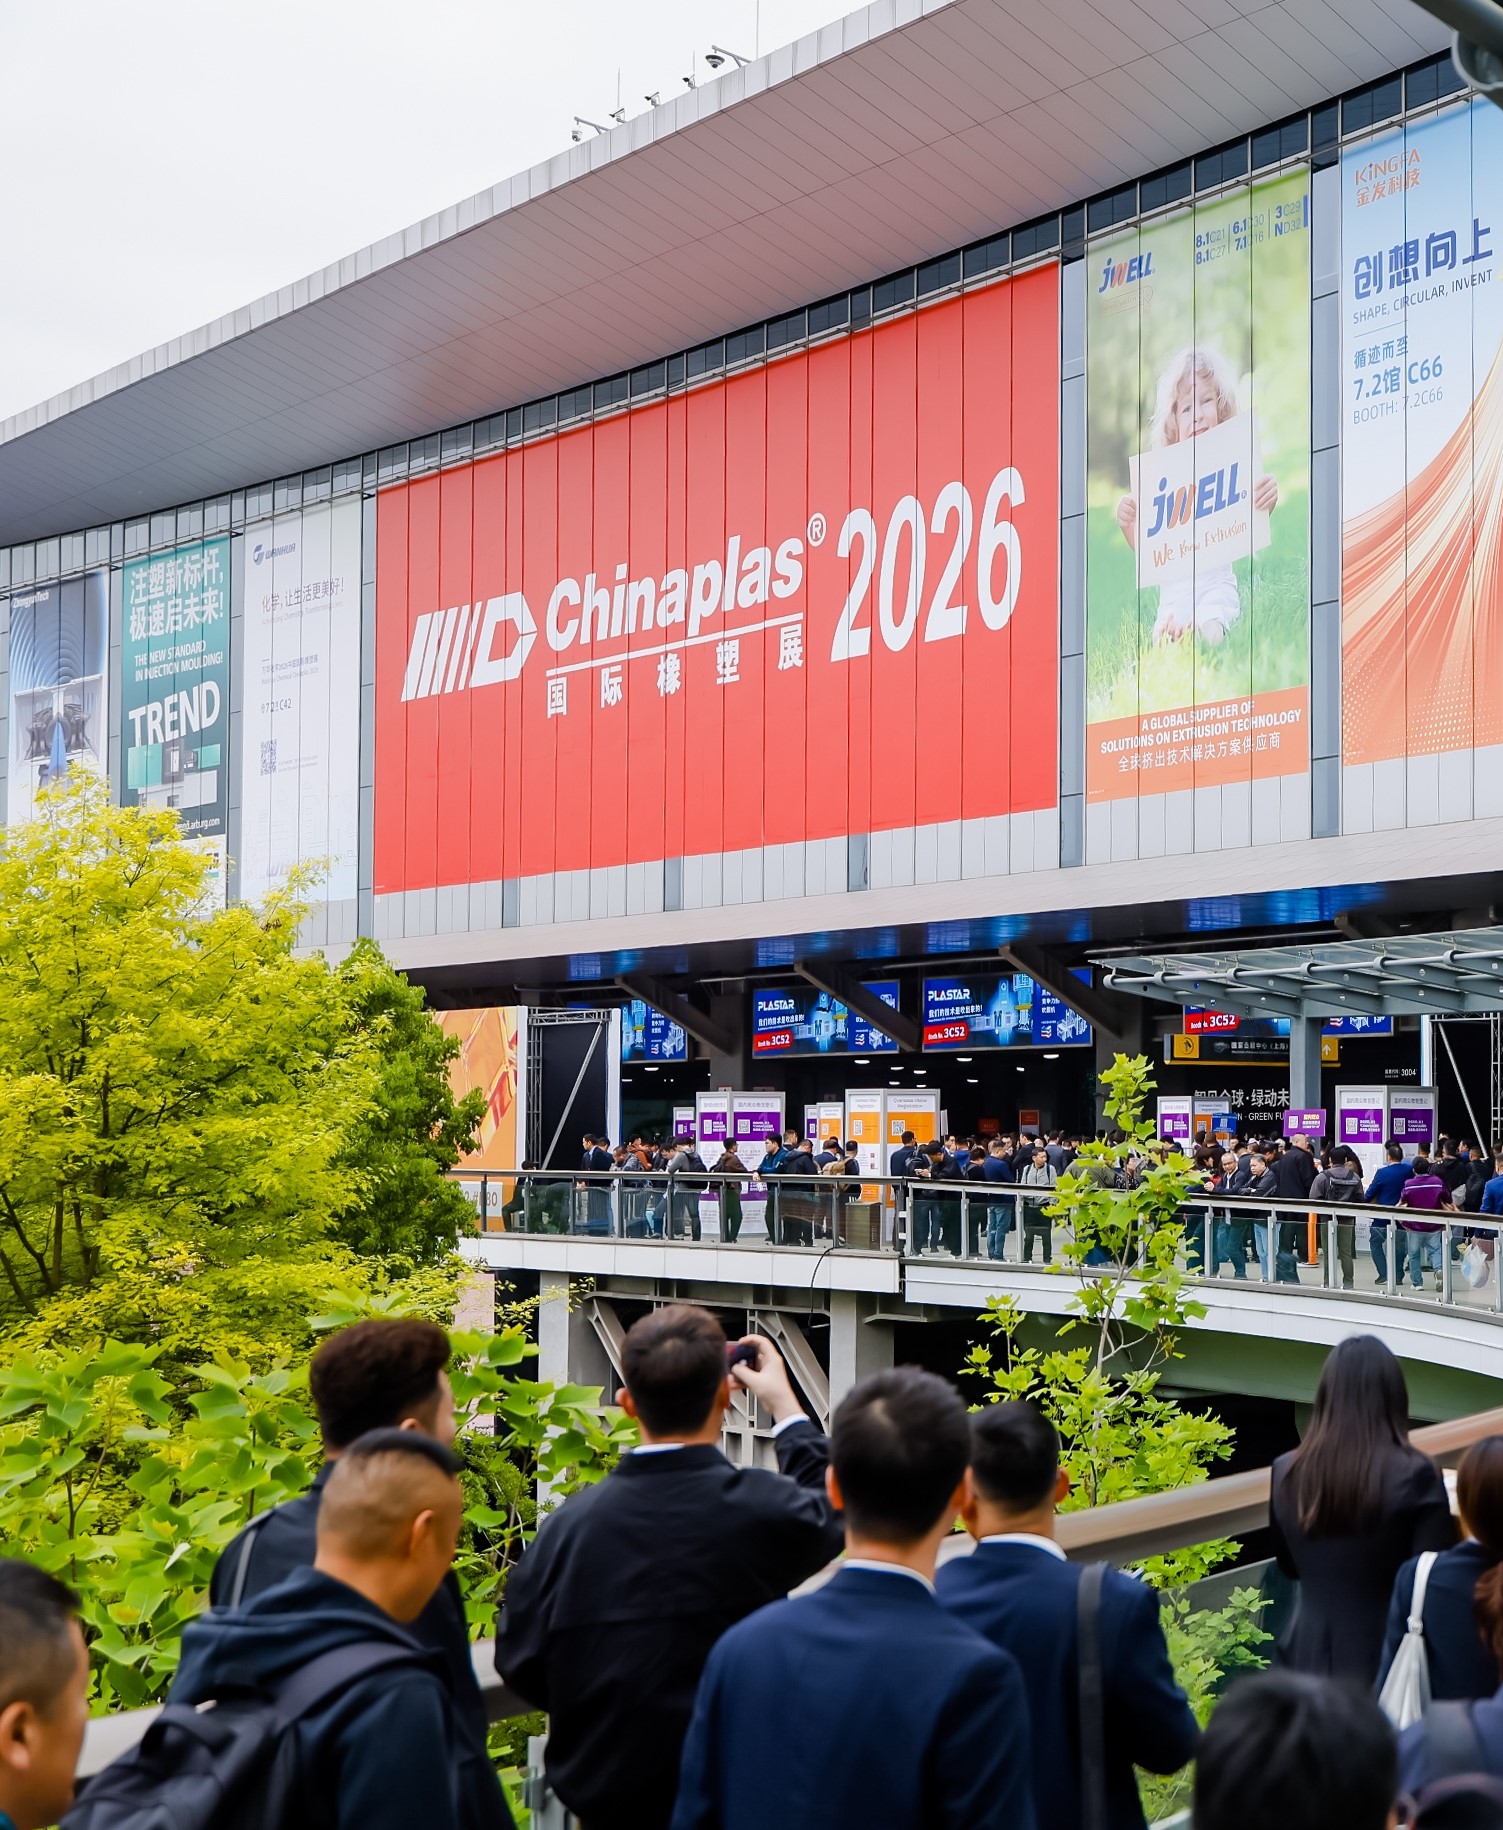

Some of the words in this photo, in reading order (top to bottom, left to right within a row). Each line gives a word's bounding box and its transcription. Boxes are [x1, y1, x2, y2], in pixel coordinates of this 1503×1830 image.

[1355, 167, 1421, 208] 金发科技
[1196, 228, 1225, 248] 8.1C21
[1275, 201, 1301, 218] 3C29
[1196, 245, 1226, 265] 8.1C27
[1275, 218, 1301, 237] ND32
[1353, 217, 1493, 300] 创想向上
[1353, 303, 1391, 324] SHAPE,
[1393, 282, 1448, 311] CIRCULAR,
[1451, 269, 1493, 292] INVENT
[1354, 335, 1409, 369] 循迹而至
[1354, 365, 1401, 401] 7.2馆
[1408, 355, 1443, 385] C66
[1353, 399, 1399, 425] BOOTH:
[1402, 386, 1443, 411] 7.2C66
[265, 543, 296, 559] WANHUA
[830, 466, 1026, 662] 2026
[1153, 543, 1175, 568] We
[1205, 520, 1247, 547] Extrusion
[135, 654, 147, 666] THE
[150, 649, 166, 663] NEW
[168, 640, 206, 660] STANDARD
[136, 669, 144, 682] IN
[145, 661, 179, 680] INJECTION
[181, 651, 223, 672] MOULDING!
[547, 623, 804, 718] 国际橡塑展
[128, 680, 221, 747] TREND
[1101, 733, 1154, 754] SOLUTIONS
[1156, 731, 1170, 745] ON
[1173, 721, 1229, 742] EXTRUSION
[1231, 708, 1302, 733] TECHNOLOGY
[1142, 719, 1149, 731] A
[1151, 713, 1189, 730] GLOBAL
[1190, 703, 1238, 723] SUPPLIER
[1241, 700, 1255, 715] OF
[1119, 731, 1280, 773] 全球挤出技术解决方案供应商
[758, 999, 795, 1011] PLASTAR
[928, 989, 970, 1001] PLASTAR
[771, 1034, 790, 1045] 3C52
[944, 1026, 965, 1038] 3C52
[1209, 1014, 1236, 1027] 3C52
[1248, 1112, 1274, 1121] GREEN
